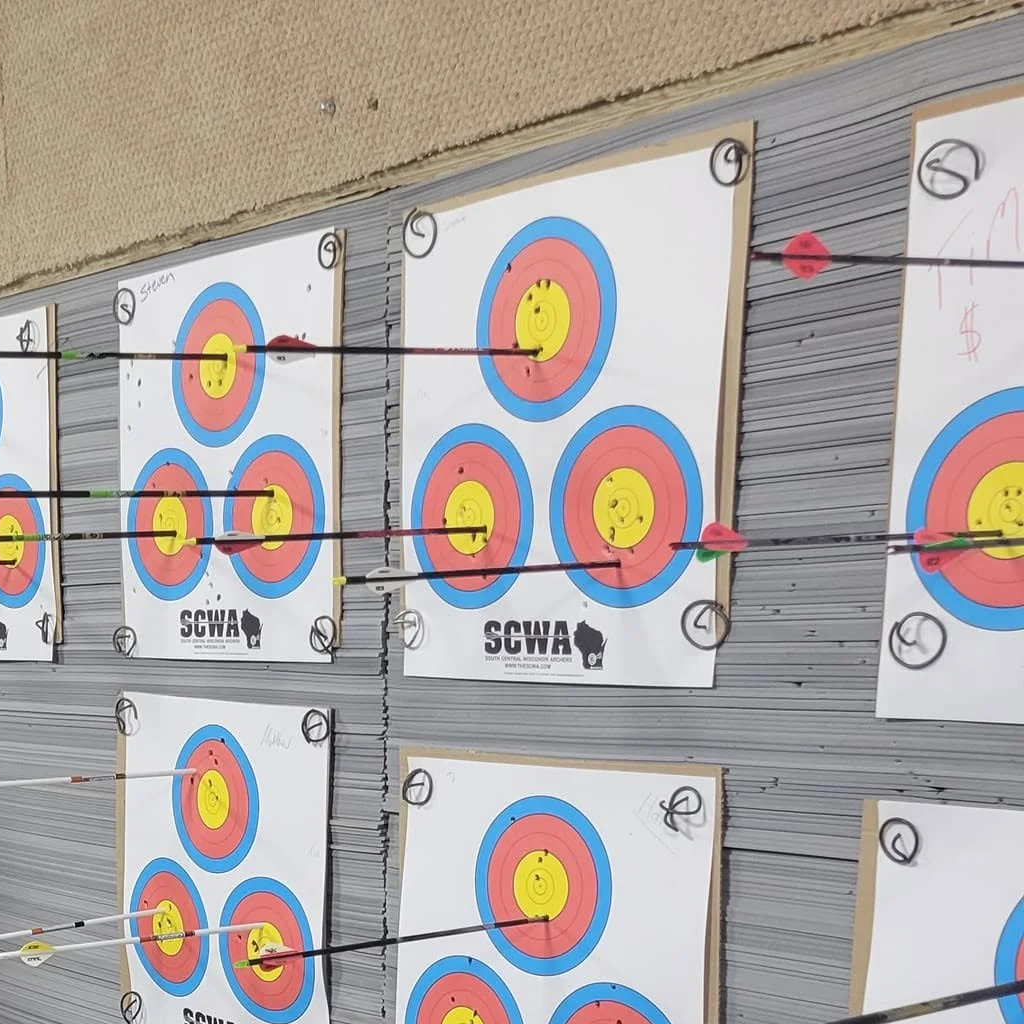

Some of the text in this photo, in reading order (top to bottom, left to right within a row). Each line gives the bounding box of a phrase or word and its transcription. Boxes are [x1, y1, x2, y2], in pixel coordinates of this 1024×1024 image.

[140, 271, 175, 303] Steven
[180, 609, 240, 638] SCWA
[484, 620, 572, 655] SCWA
